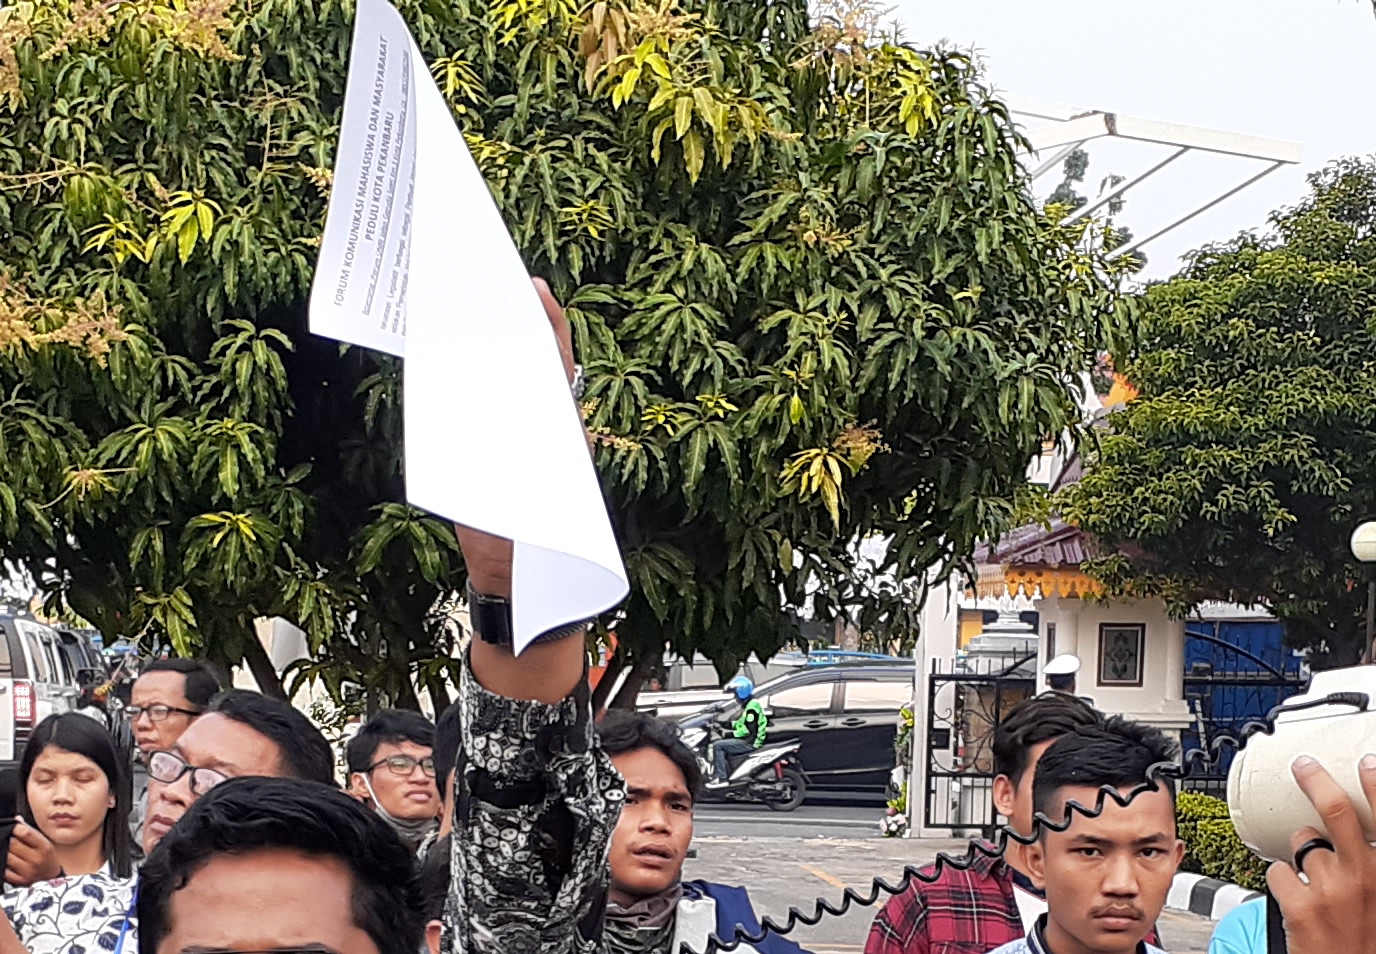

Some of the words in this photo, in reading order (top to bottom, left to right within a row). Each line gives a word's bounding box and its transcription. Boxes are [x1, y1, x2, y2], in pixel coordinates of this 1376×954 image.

[373, 34, 389, 108] MASYARAKAT
[368, 108, 380, 132] DAN
[377, 111, 395, 174] PEKANBARU
[357, 134, 376, 198] MAHASISWA
[371, 170, 386, 203] KOTA
[344, 196, 365, 268] KOMUNIKASI
[364, 203, 380, 242] PEDULI
